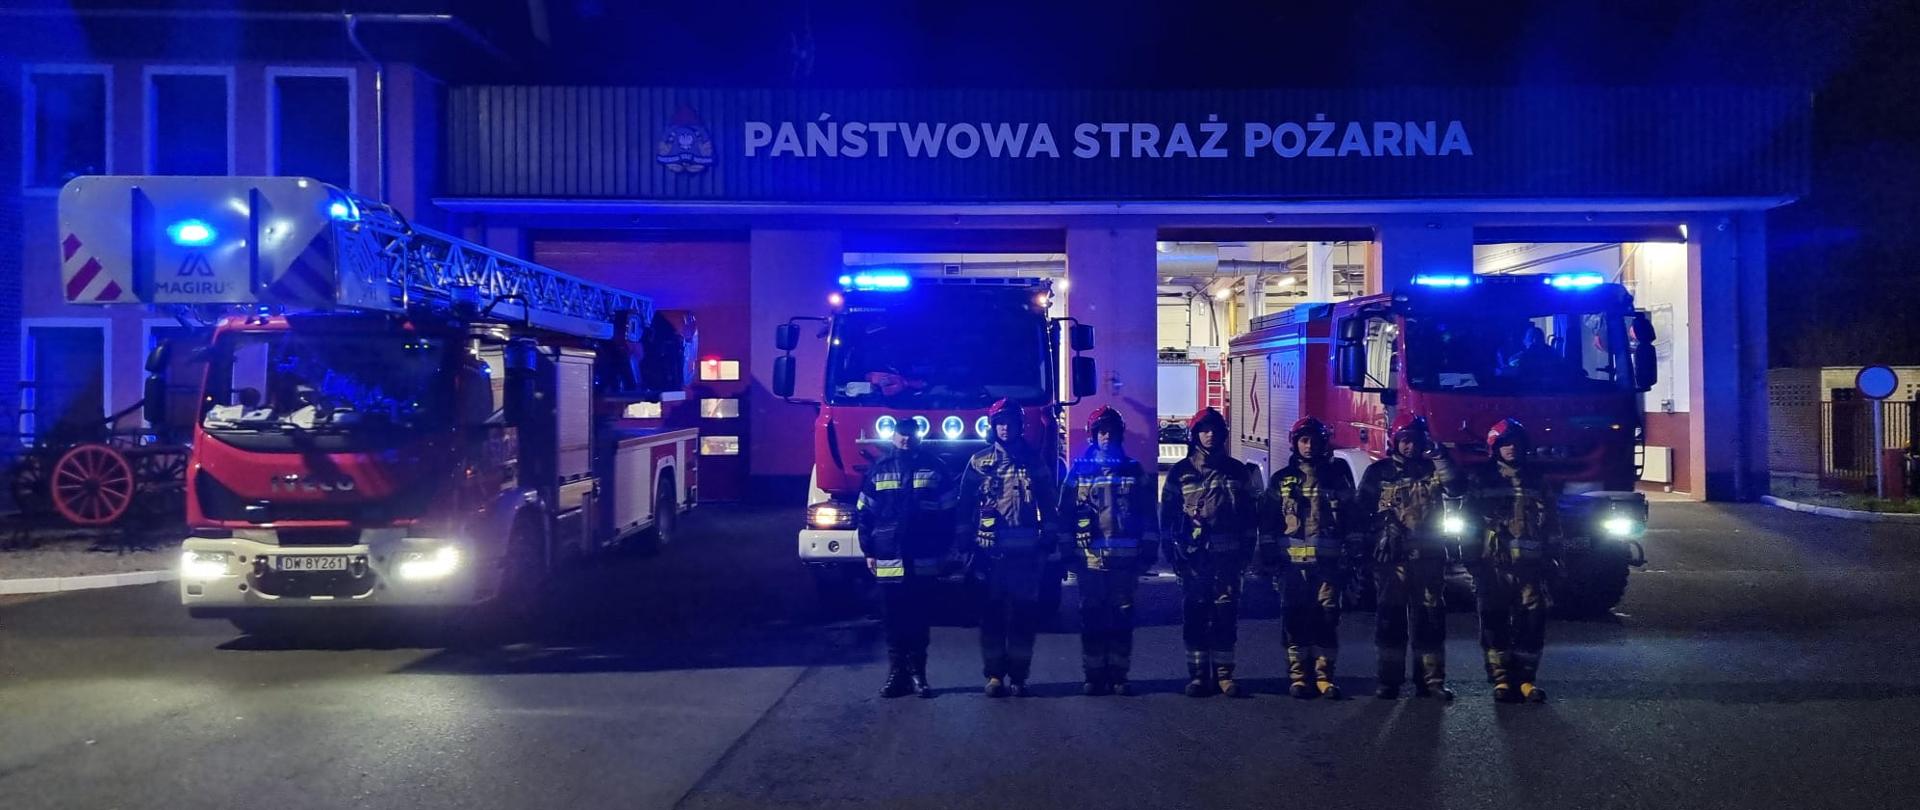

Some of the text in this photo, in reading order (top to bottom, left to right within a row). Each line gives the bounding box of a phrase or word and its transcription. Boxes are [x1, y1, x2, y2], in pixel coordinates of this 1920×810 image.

[744, 112, 1473, 158] PAŃSTWOWA STRAŻ POŻARNA
[285, 558, 301, 569] DW
[305, 557, 343, 569] 8Y261
